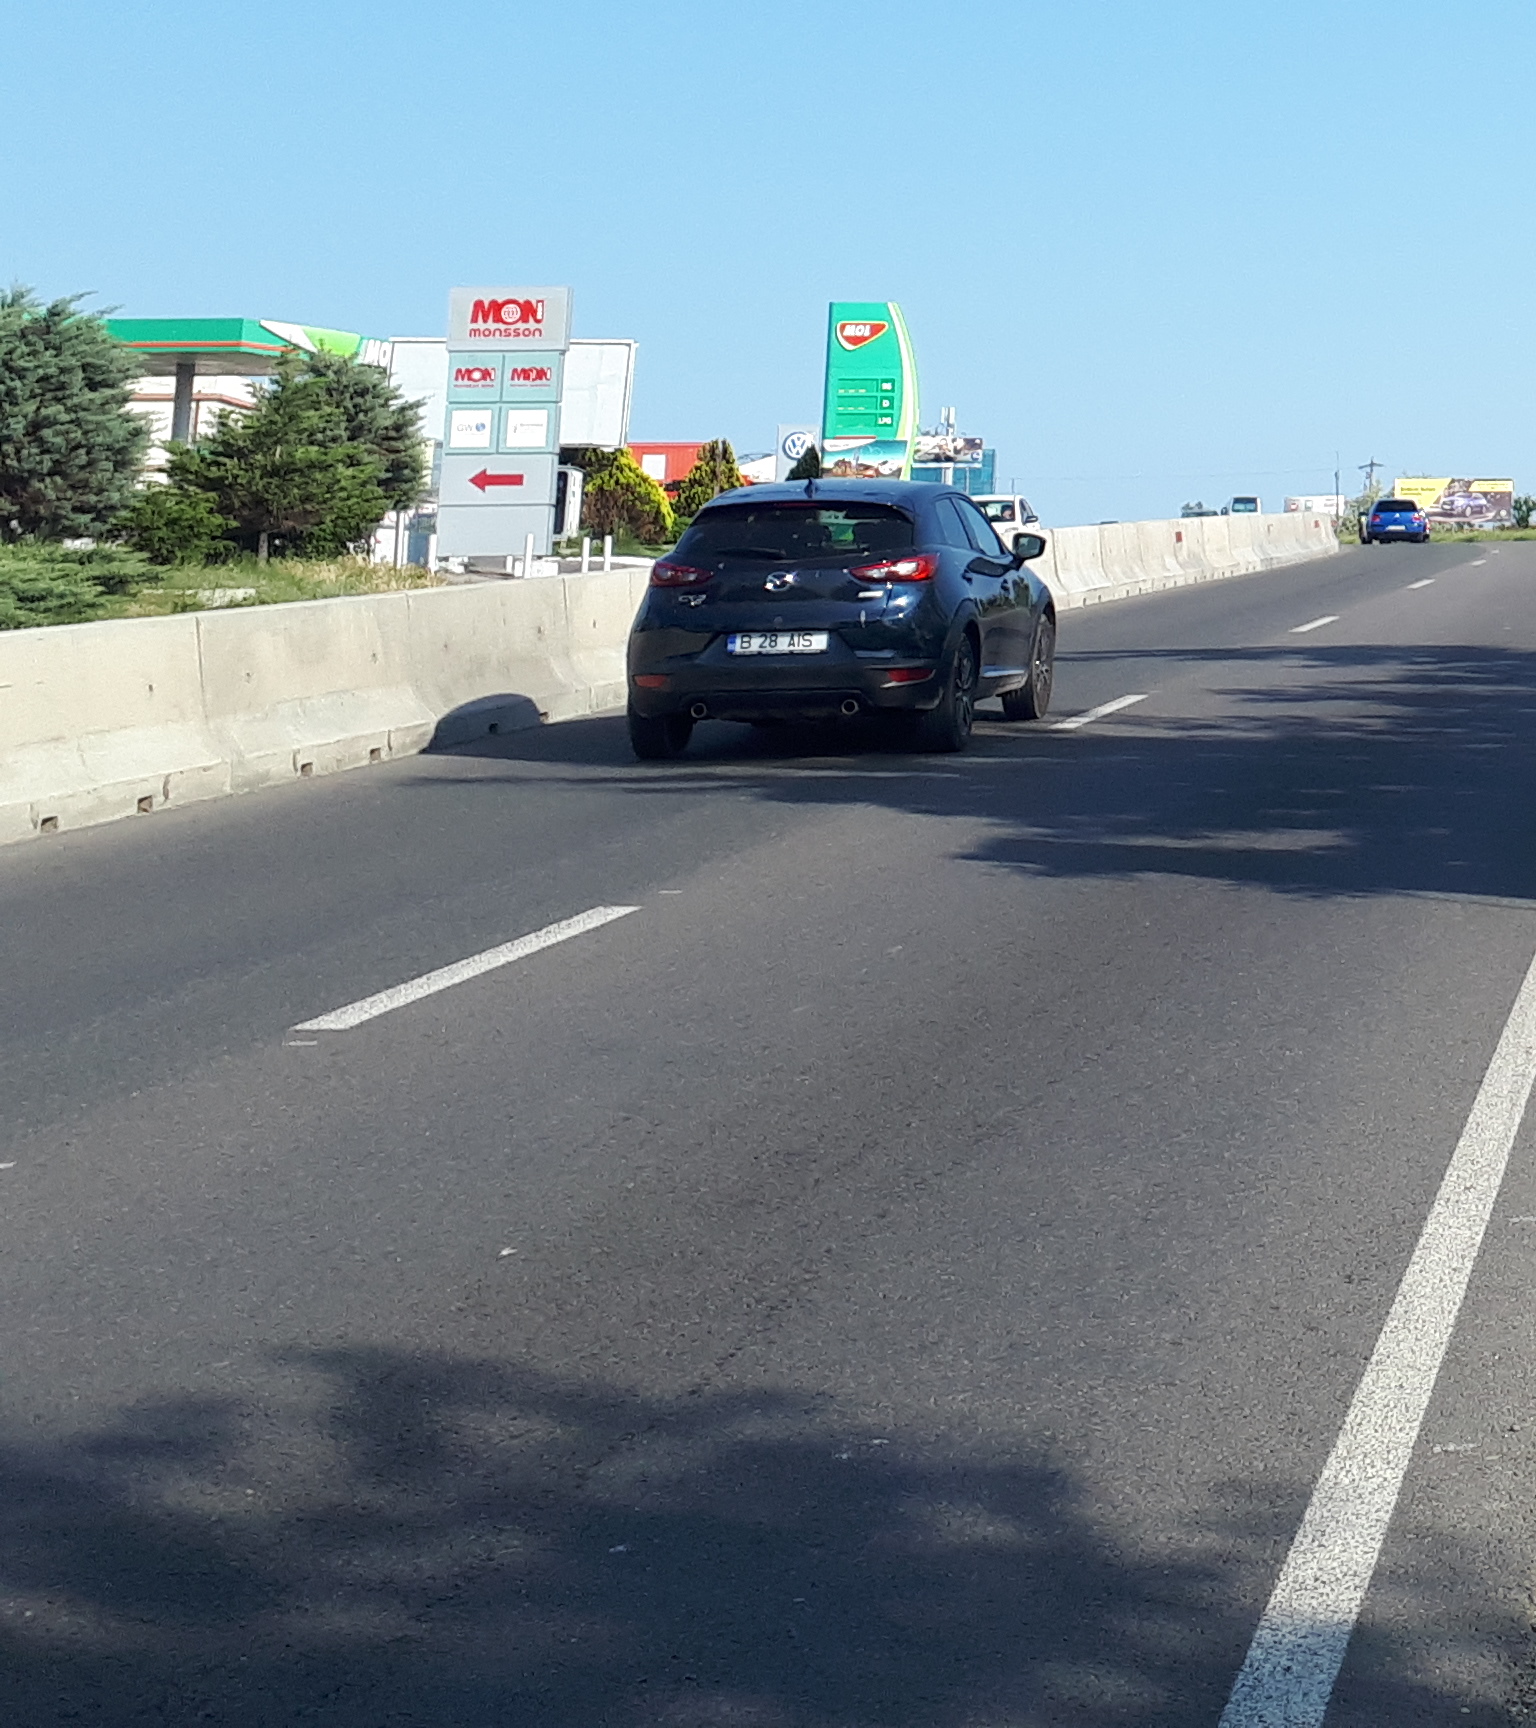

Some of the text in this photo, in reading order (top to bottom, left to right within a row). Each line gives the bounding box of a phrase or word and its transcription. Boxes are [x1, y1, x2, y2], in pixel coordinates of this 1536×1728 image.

[470, 299, 544, 325] MON
[469, 328, 543, 338] monsson
[843, 324, 871, 336] MOL
[363, 339, 391, 367] MO
[454, 367, 496, 382] MON
[740, 635, 751, 649] B
[759, 634, 778, 648] 28
[788, 633, 813, 648] AIS
